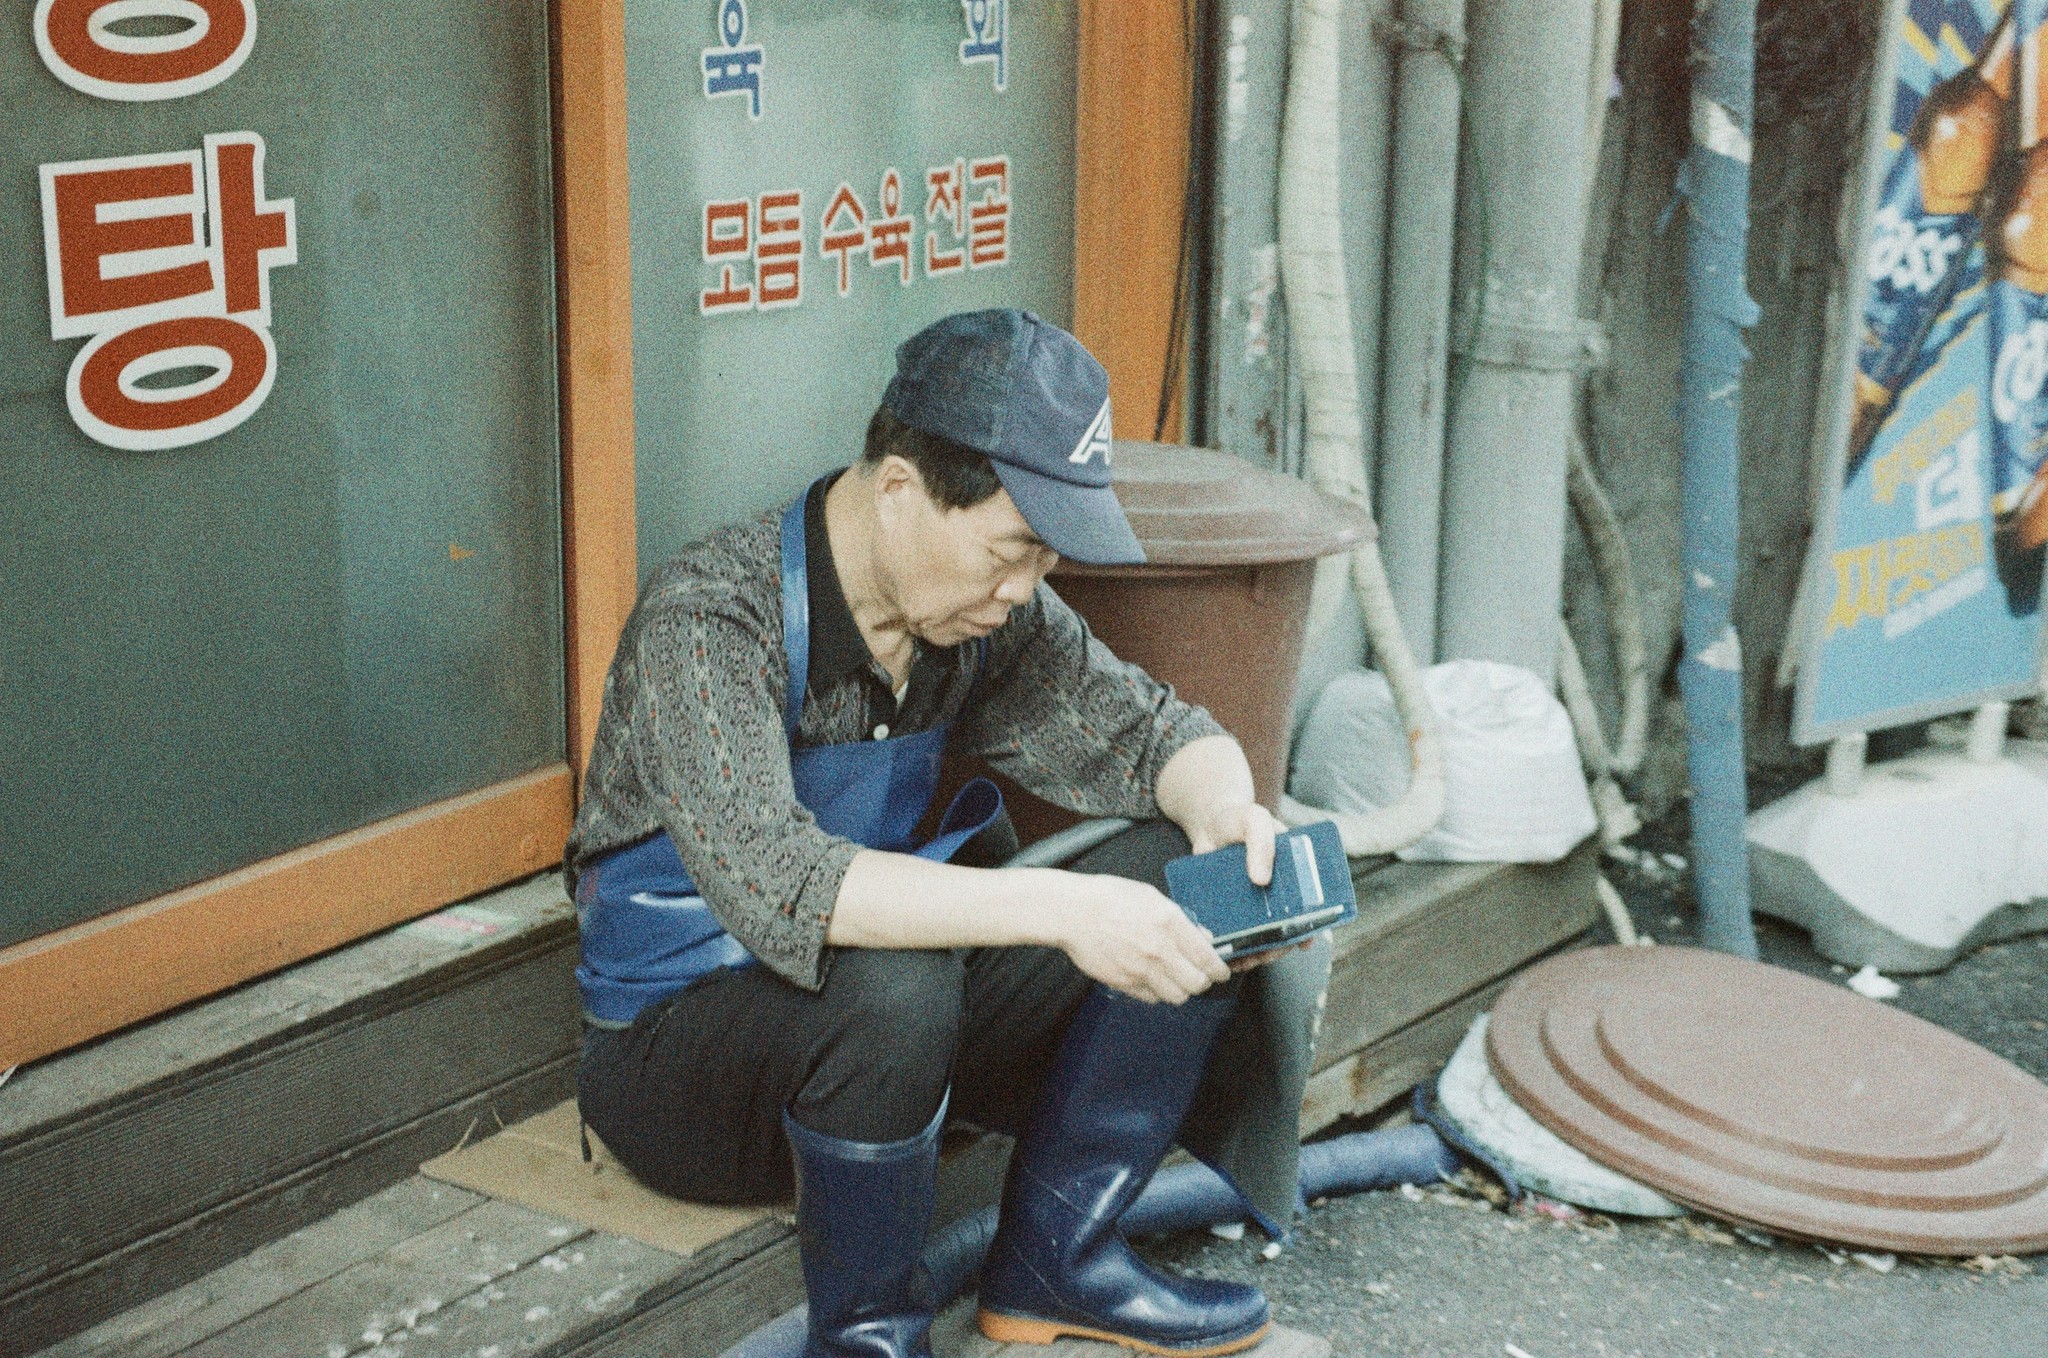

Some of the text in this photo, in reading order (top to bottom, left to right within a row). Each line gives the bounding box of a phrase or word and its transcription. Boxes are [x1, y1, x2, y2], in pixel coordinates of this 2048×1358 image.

[701, 155, 1010, 316] 모듬 수육 전골
[1068, 395, 1113, 466] A
